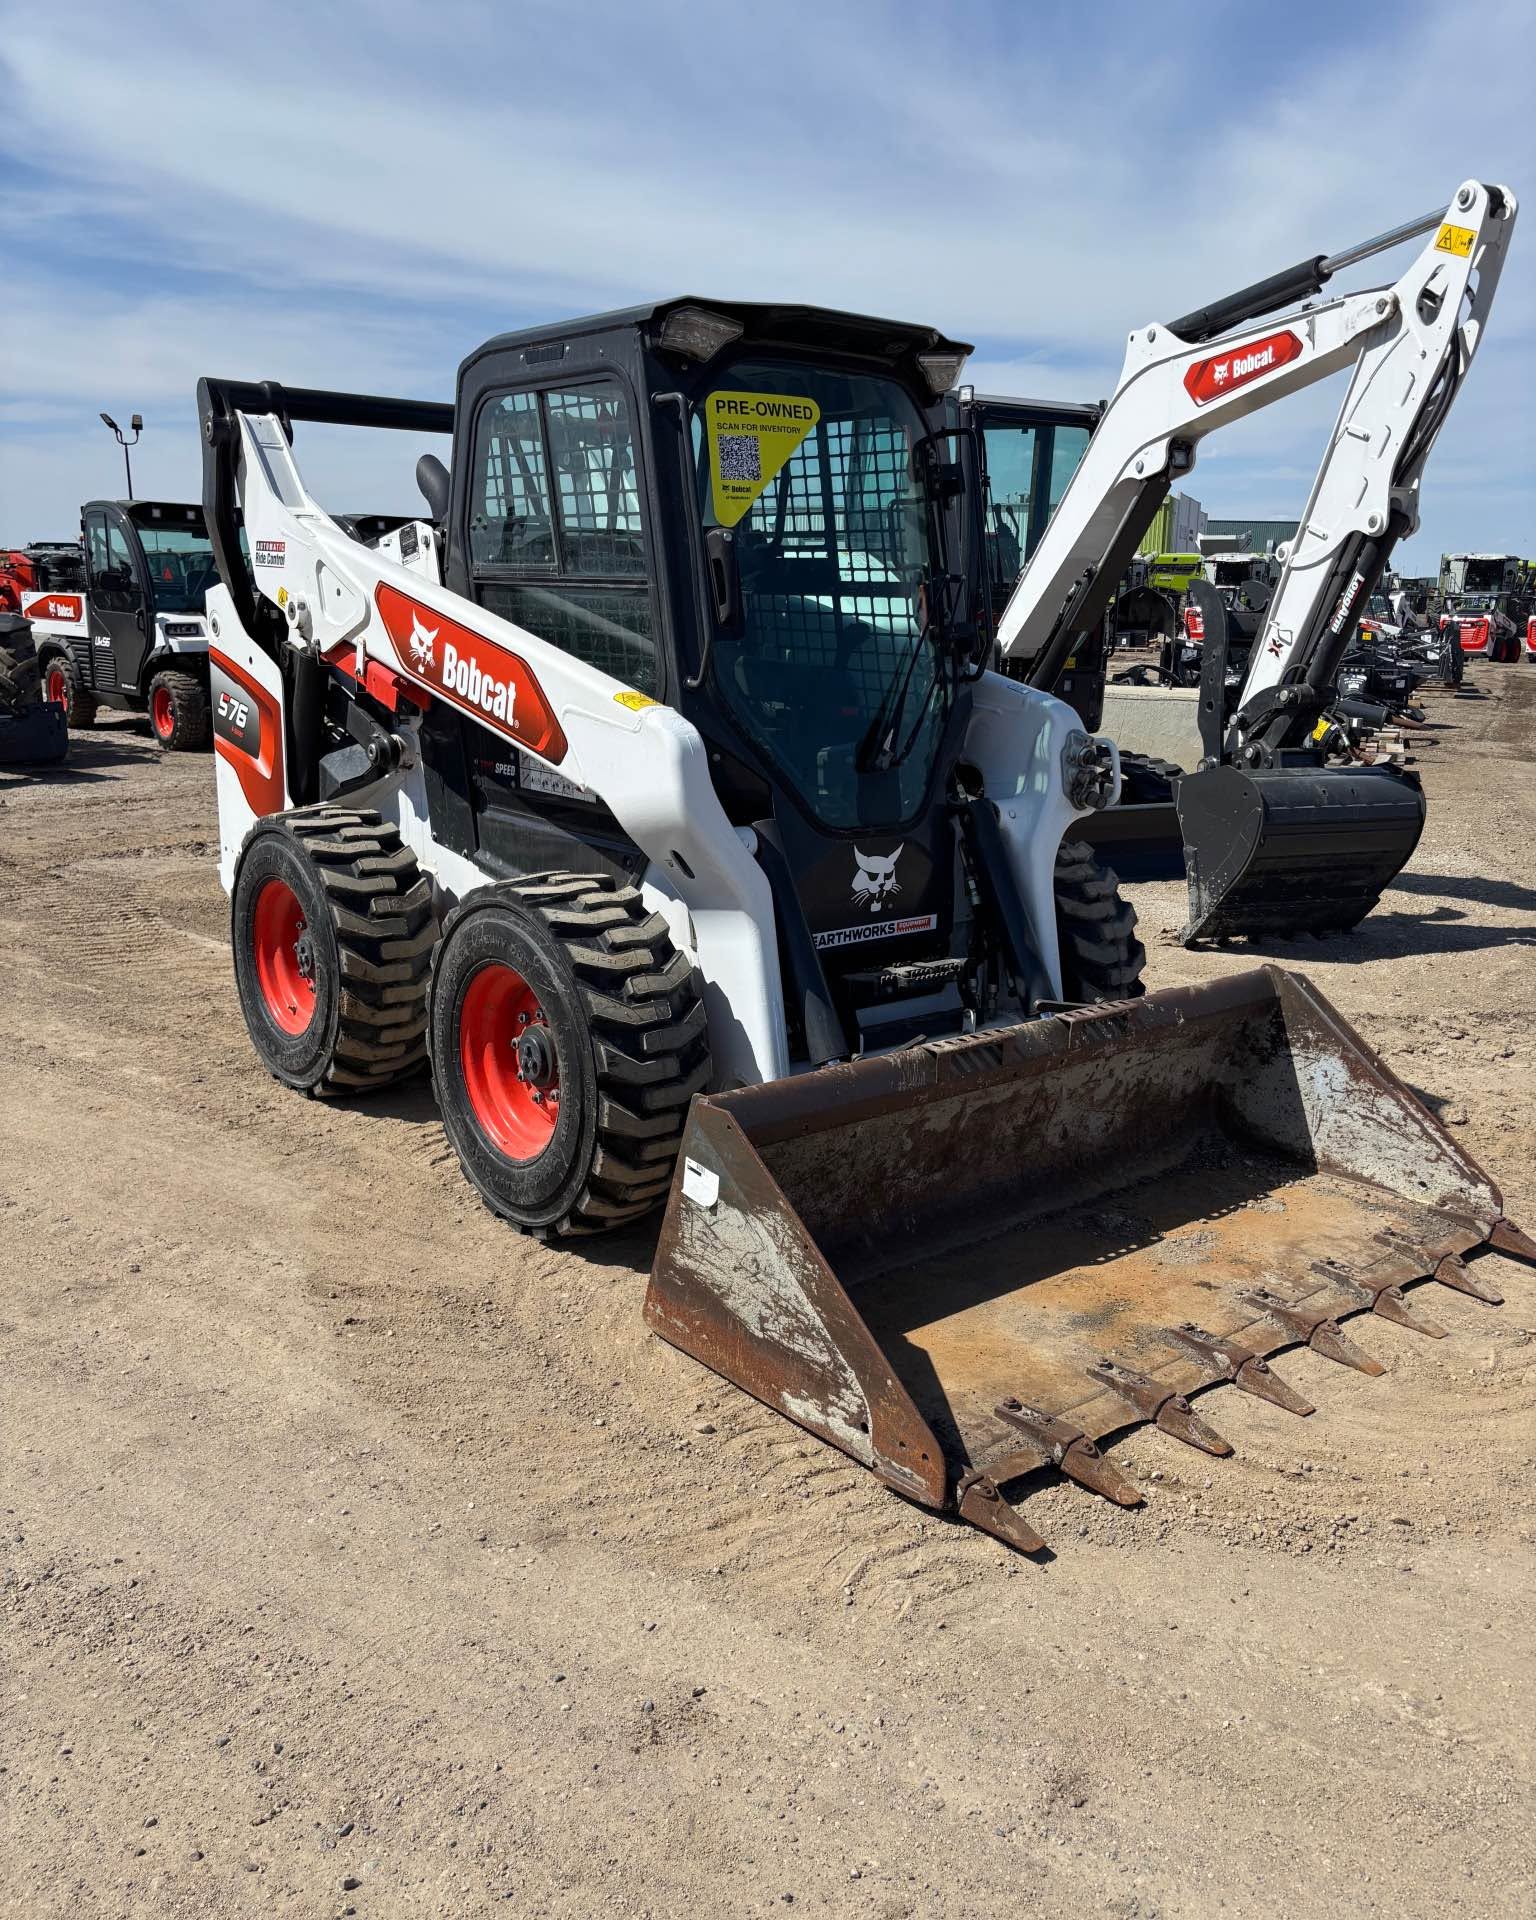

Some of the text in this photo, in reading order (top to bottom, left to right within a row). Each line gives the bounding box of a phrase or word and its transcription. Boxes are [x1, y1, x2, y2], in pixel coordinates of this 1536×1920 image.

[1232, 345, 1274, 379] Bobcat
[715, 399, 814, 420] PRE-OWNED
[716, 422, 801, 434] SCAN FOR INVENTORY
[256, 542, 285, 551] AUTOMATIC
[255, 552, 286, 566] Ride Control
[57, 603, 75, 618] Bobcat
[442, 642, 517, 727] Bobcat
[494, 762, 516, 777] SPEED
[812, 922, 896, 947] EARTHWORKS
